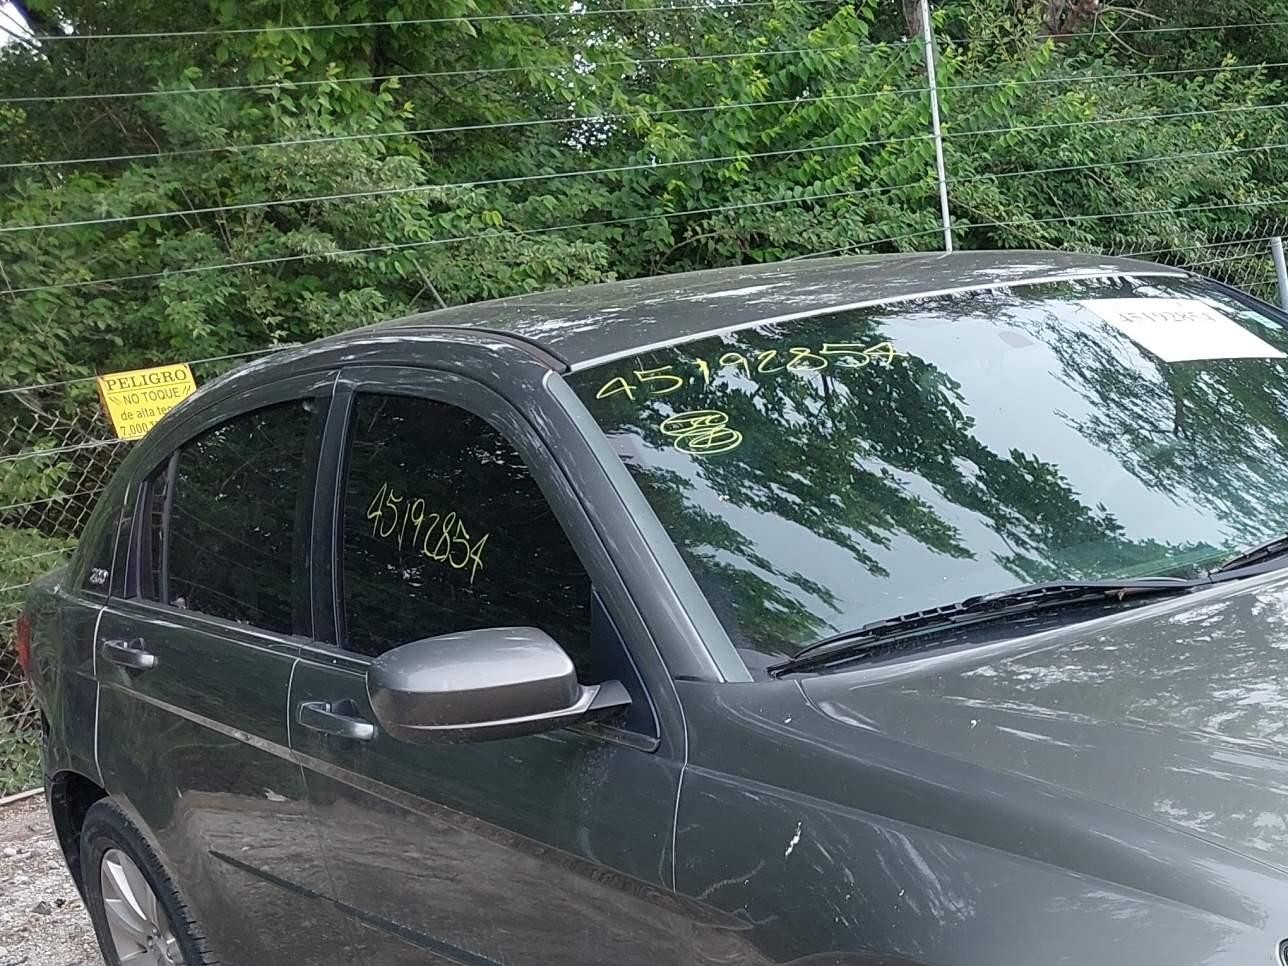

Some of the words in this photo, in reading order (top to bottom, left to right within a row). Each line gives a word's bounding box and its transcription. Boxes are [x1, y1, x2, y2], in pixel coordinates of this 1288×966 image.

[106, 369, 187, 391] PELIGRO
[595, 342, 908, 401] 45192854
[122, 393, 140, 406] NO
[141, 387, 181, 403] TOQUE
[121, 410, 133, 421] de
[137, 406, 155, 419] alta
[367, 482, 489, 584] 45192854
